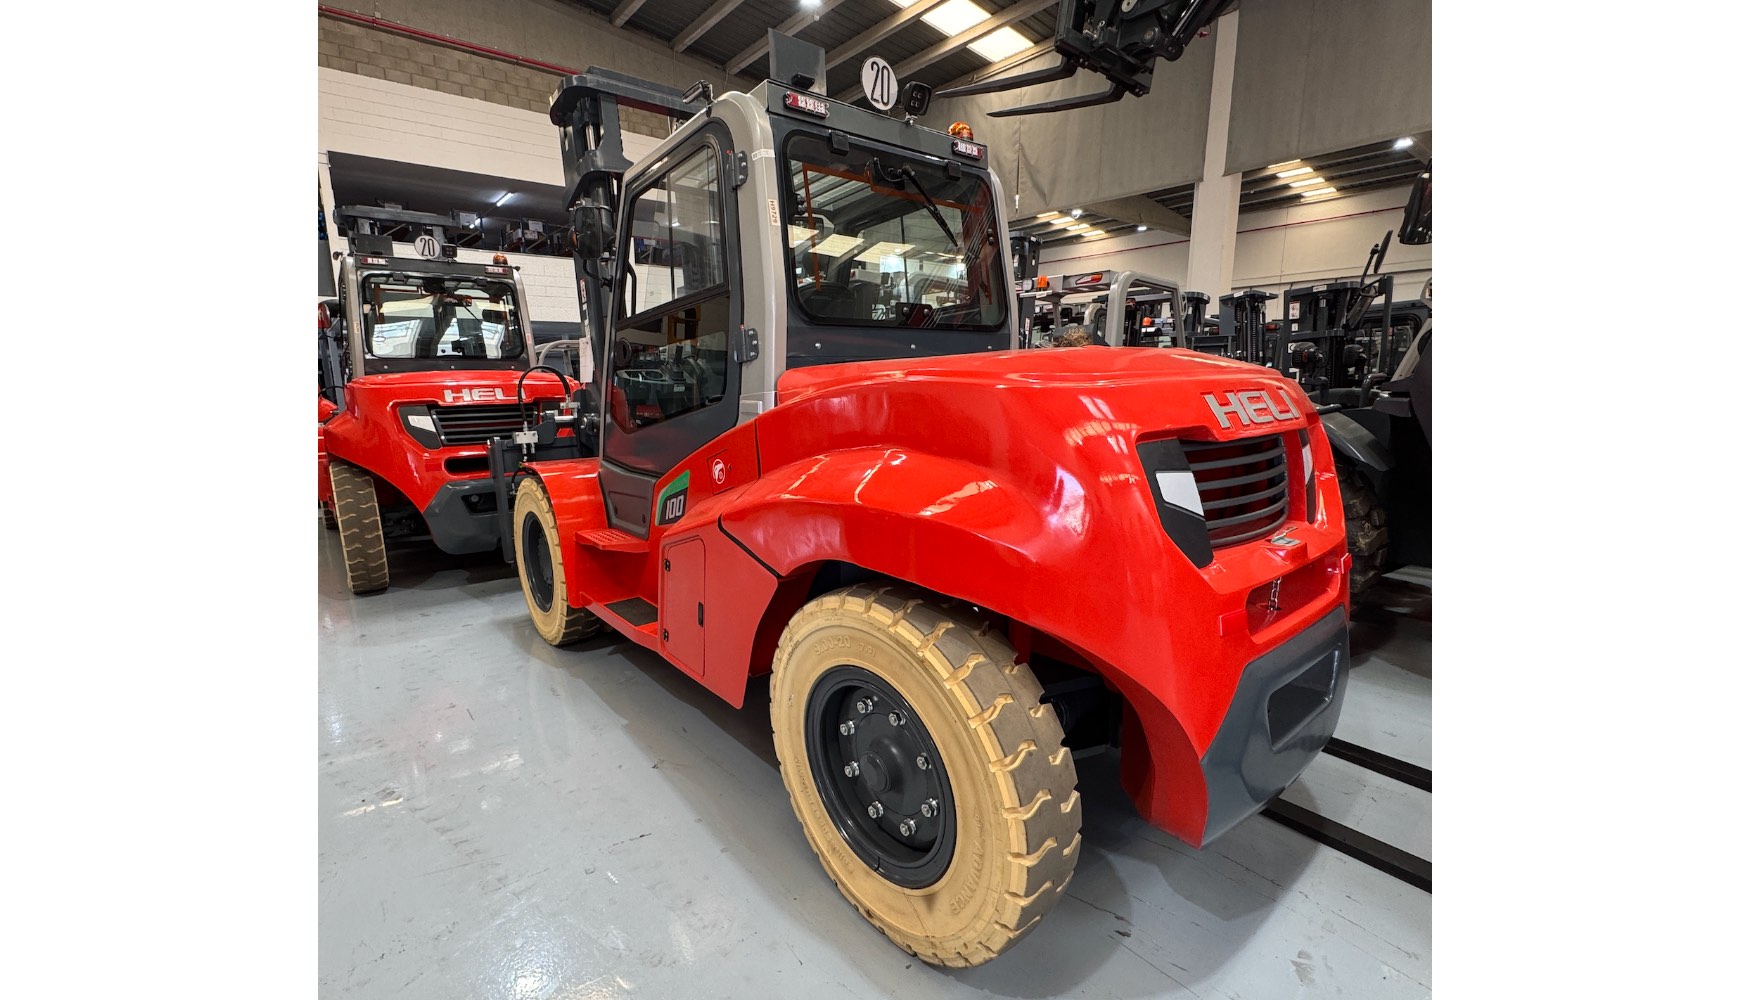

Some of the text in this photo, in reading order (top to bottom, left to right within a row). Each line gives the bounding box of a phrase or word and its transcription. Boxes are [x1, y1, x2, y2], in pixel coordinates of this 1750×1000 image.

[870, 61, 890, 107] 20
[420, 237, 435, 257] 20
[1203, 390, 1300, 429] HELI
[665, 495, 684, 520] 100
